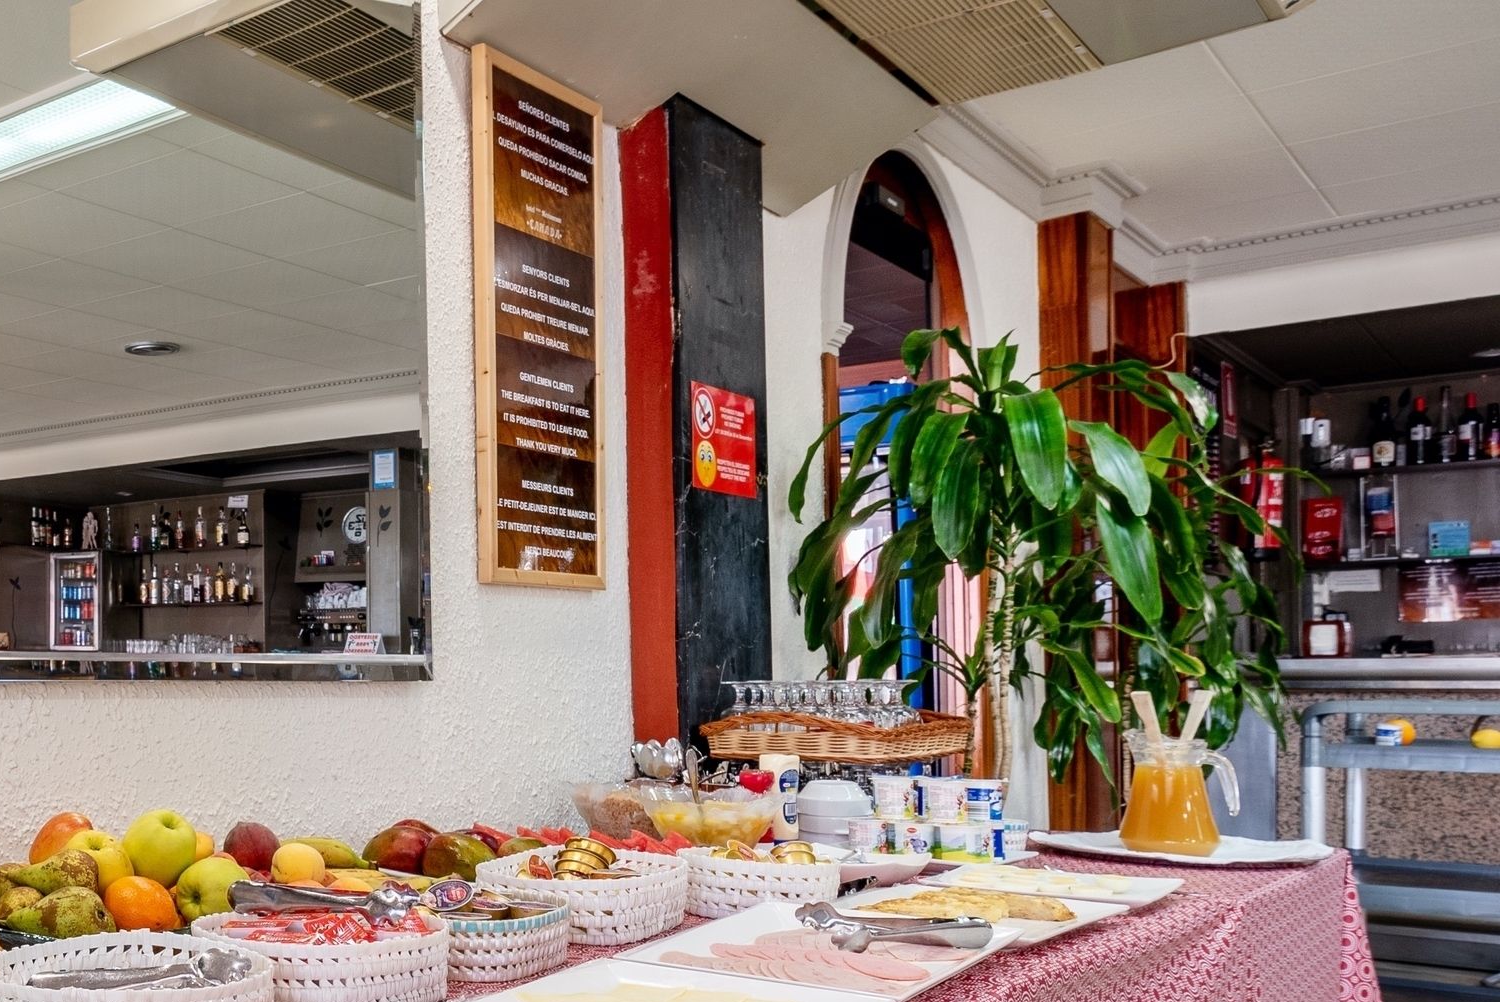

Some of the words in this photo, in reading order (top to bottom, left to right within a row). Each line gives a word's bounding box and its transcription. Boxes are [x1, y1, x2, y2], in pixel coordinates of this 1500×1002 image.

[518, 100, 544, 120] SEÑORES
[544, 113, 570, 133] CLIENTES
[496, 112, 527, 135] DESAYUNO
[527, 127, 536, 138] ES
[535, 131, 551, 146] PARA
[550, 137, 582, 160] COMERSELO
[497, 136, 518, 152] QUEDA
[518, 145, 548, 166] PROHIBIDO
[548, 158, 567, 175] SACAR
[520, 168, 544, 186] MUCHAS
[522, 264, 548, 281] SENYORS
[547, 273, 570, 288] CLIENTS
[528, 287, 537, 299] ÉS
[537, 291, 549, 303] PER
[500, 302, 521, 316] QUEDA
[520, 307, 546, 324] PROHIBIT
[546, 315, 568, 329] TREURE
[523, 331, 545, 346] MOLTES
[519, 371, 552, 388] GENTLEMEN
[552, 380, 574, 393] CLIENTS
[501, 389, 513, 400] THE
[513, 392, 545, 408] BREAKFAST
[545, 400, 551, 409] IS
[551, 401, 559, 411] TO
[559, 403, 569, 413] EAT
[569, 405, 575, 414] IT
[575, 407, 591, 419] HERE.
[503, 412, 509, 422] IT
[509, 414, 516, 423] IS
[516, 415, 548, 431] PROHIBITED
[548, 421, 556, 432] TO
[556, 424, 573, 436] LEAVE
[573, 428, 589, 439] FOOD.
[516, 437, 536, 450] THANK
[535, 441, 547, 452] YOU
[547, 443, 561, 454] VERY
[521, 479, 552, 493] MESSIEURS
[552, 485, 574, 497] CLIENTS
[548, 506, 559, 515] EST
[558, 507, 567, 517] DE
[567, 509, 589, 520] MANGER
[507, 521, 533, 533] INTERDIT
[533, 525, 541, 534] DE
[541, 526, 566, 538] PRENDRE
[566, 530, 576, 540] LES
